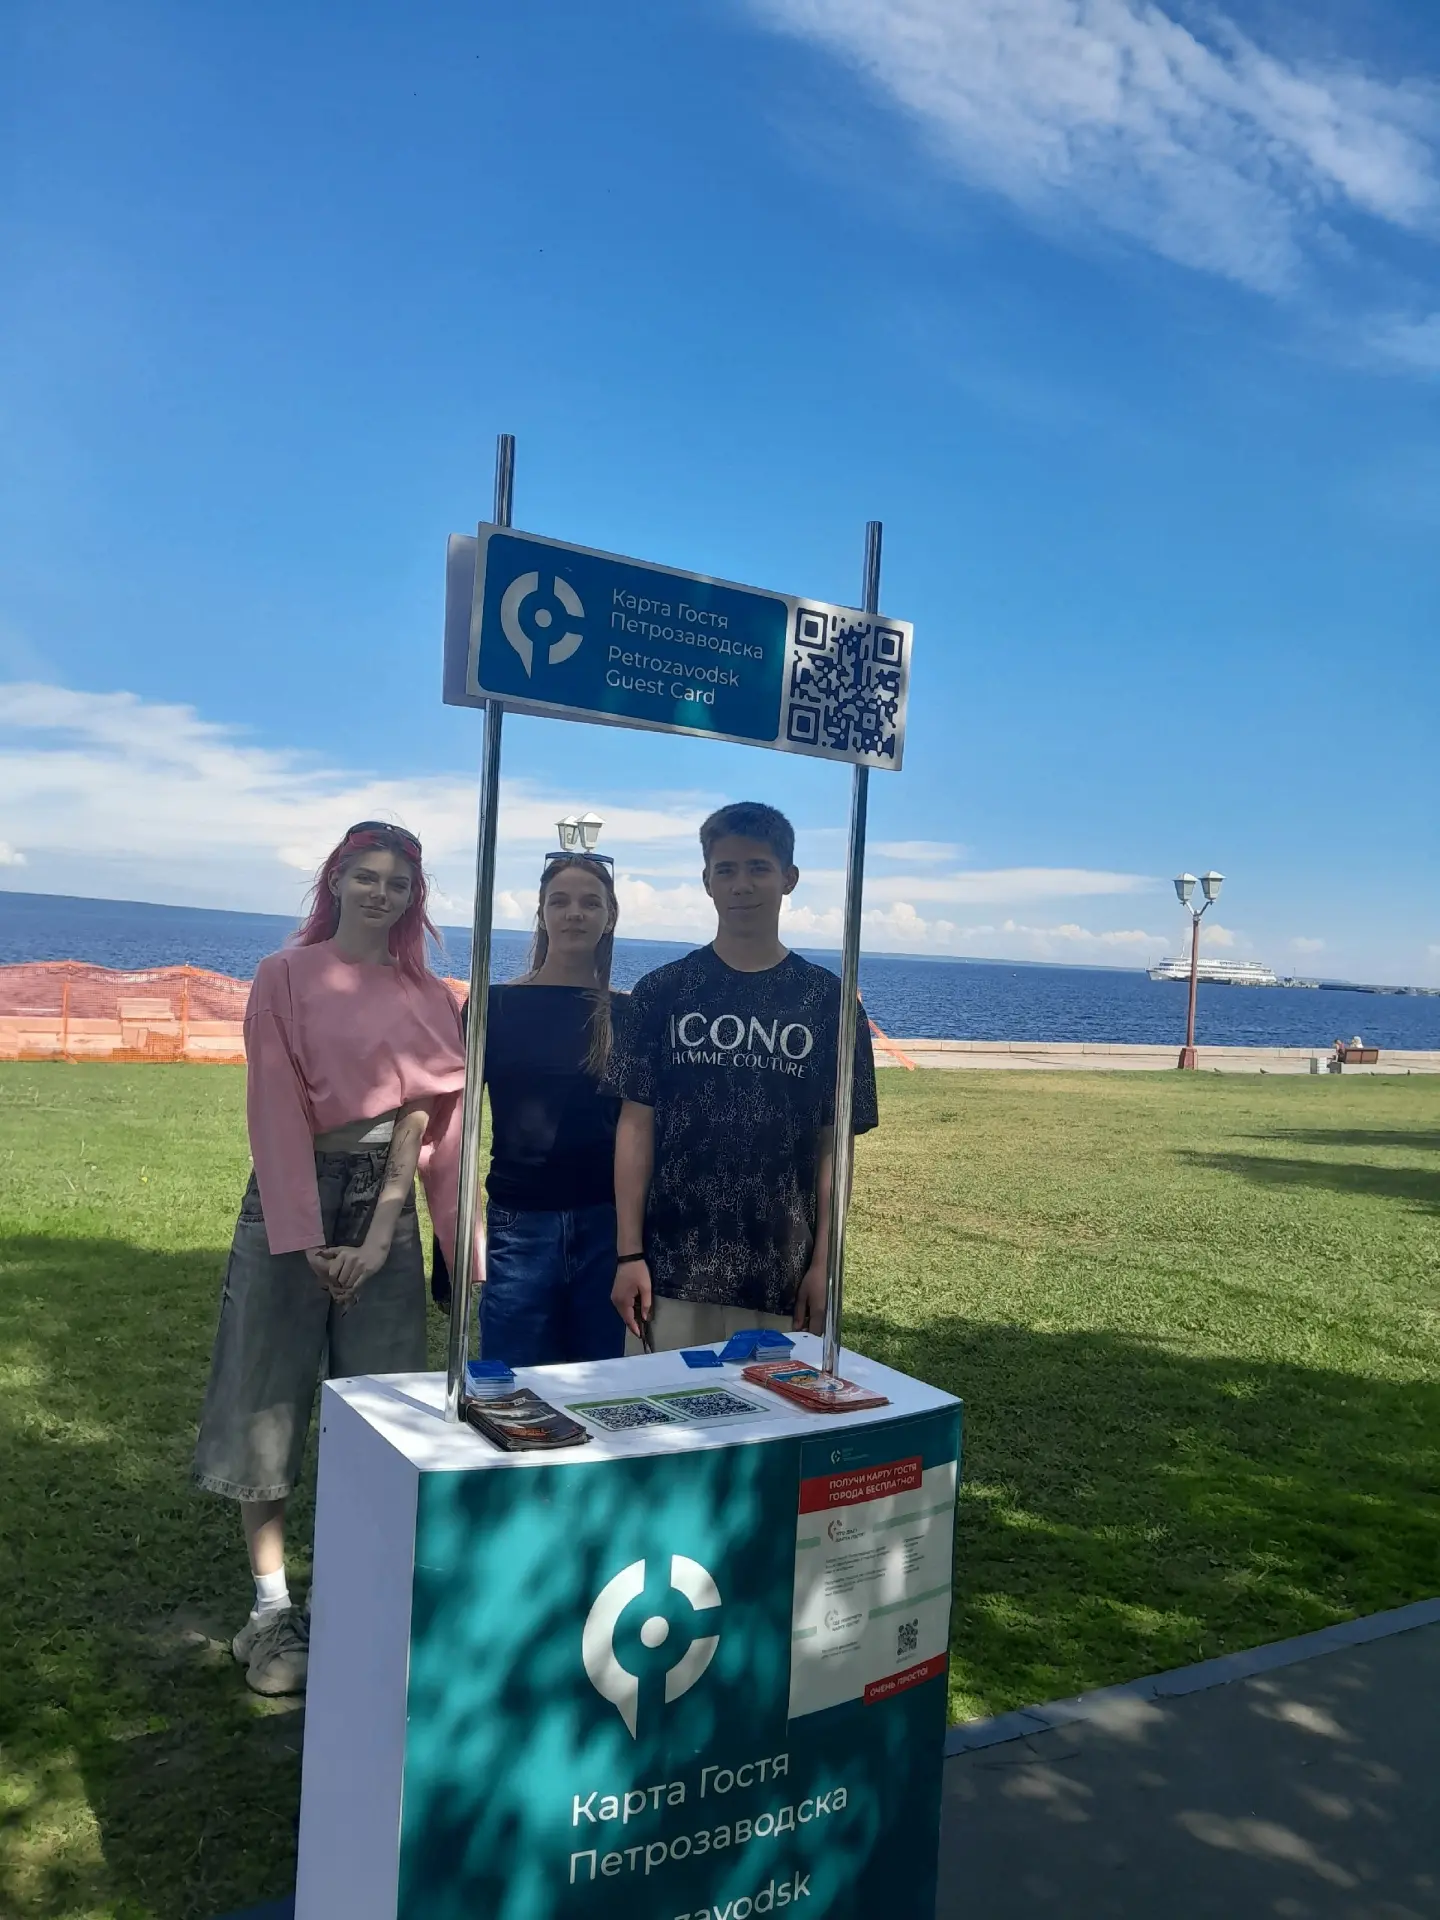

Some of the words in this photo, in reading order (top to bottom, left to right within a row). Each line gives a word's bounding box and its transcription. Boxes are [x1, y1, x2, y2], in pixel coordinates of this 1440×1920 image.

[612, 588, 671, 617] Карта
[678, 603, 728, 629] Гостя
[611, 611, 763, 659] Петрозаводска
[608, 645, 740, 687] Petrozavodsk
[606, 669, 665, 696] Guest
[670, 682, 715, 705] Card
[669, 1012, 814, 1060] ICONO
[733, 1053, 808, 1079] COUTURE
[829, 1475, 866, 1489] ПОЛУЧИ
[866, 1469, 892, 1482] КАРТУ
[893, 1463, 917, 1475] ГОСТЯ
[829, 1489, 864, 1502] ГОРОДА
[865, 1476, 915, 1495] БЕСПЛАТНО!
[869, 1682, 896, 1697] ОЧЕНЬ
[572, 1781, 686, 1826] Карта
[700, 1753, 789, 1798] Гостя
[569, 1787, 848, 1884] Петрозаводска
